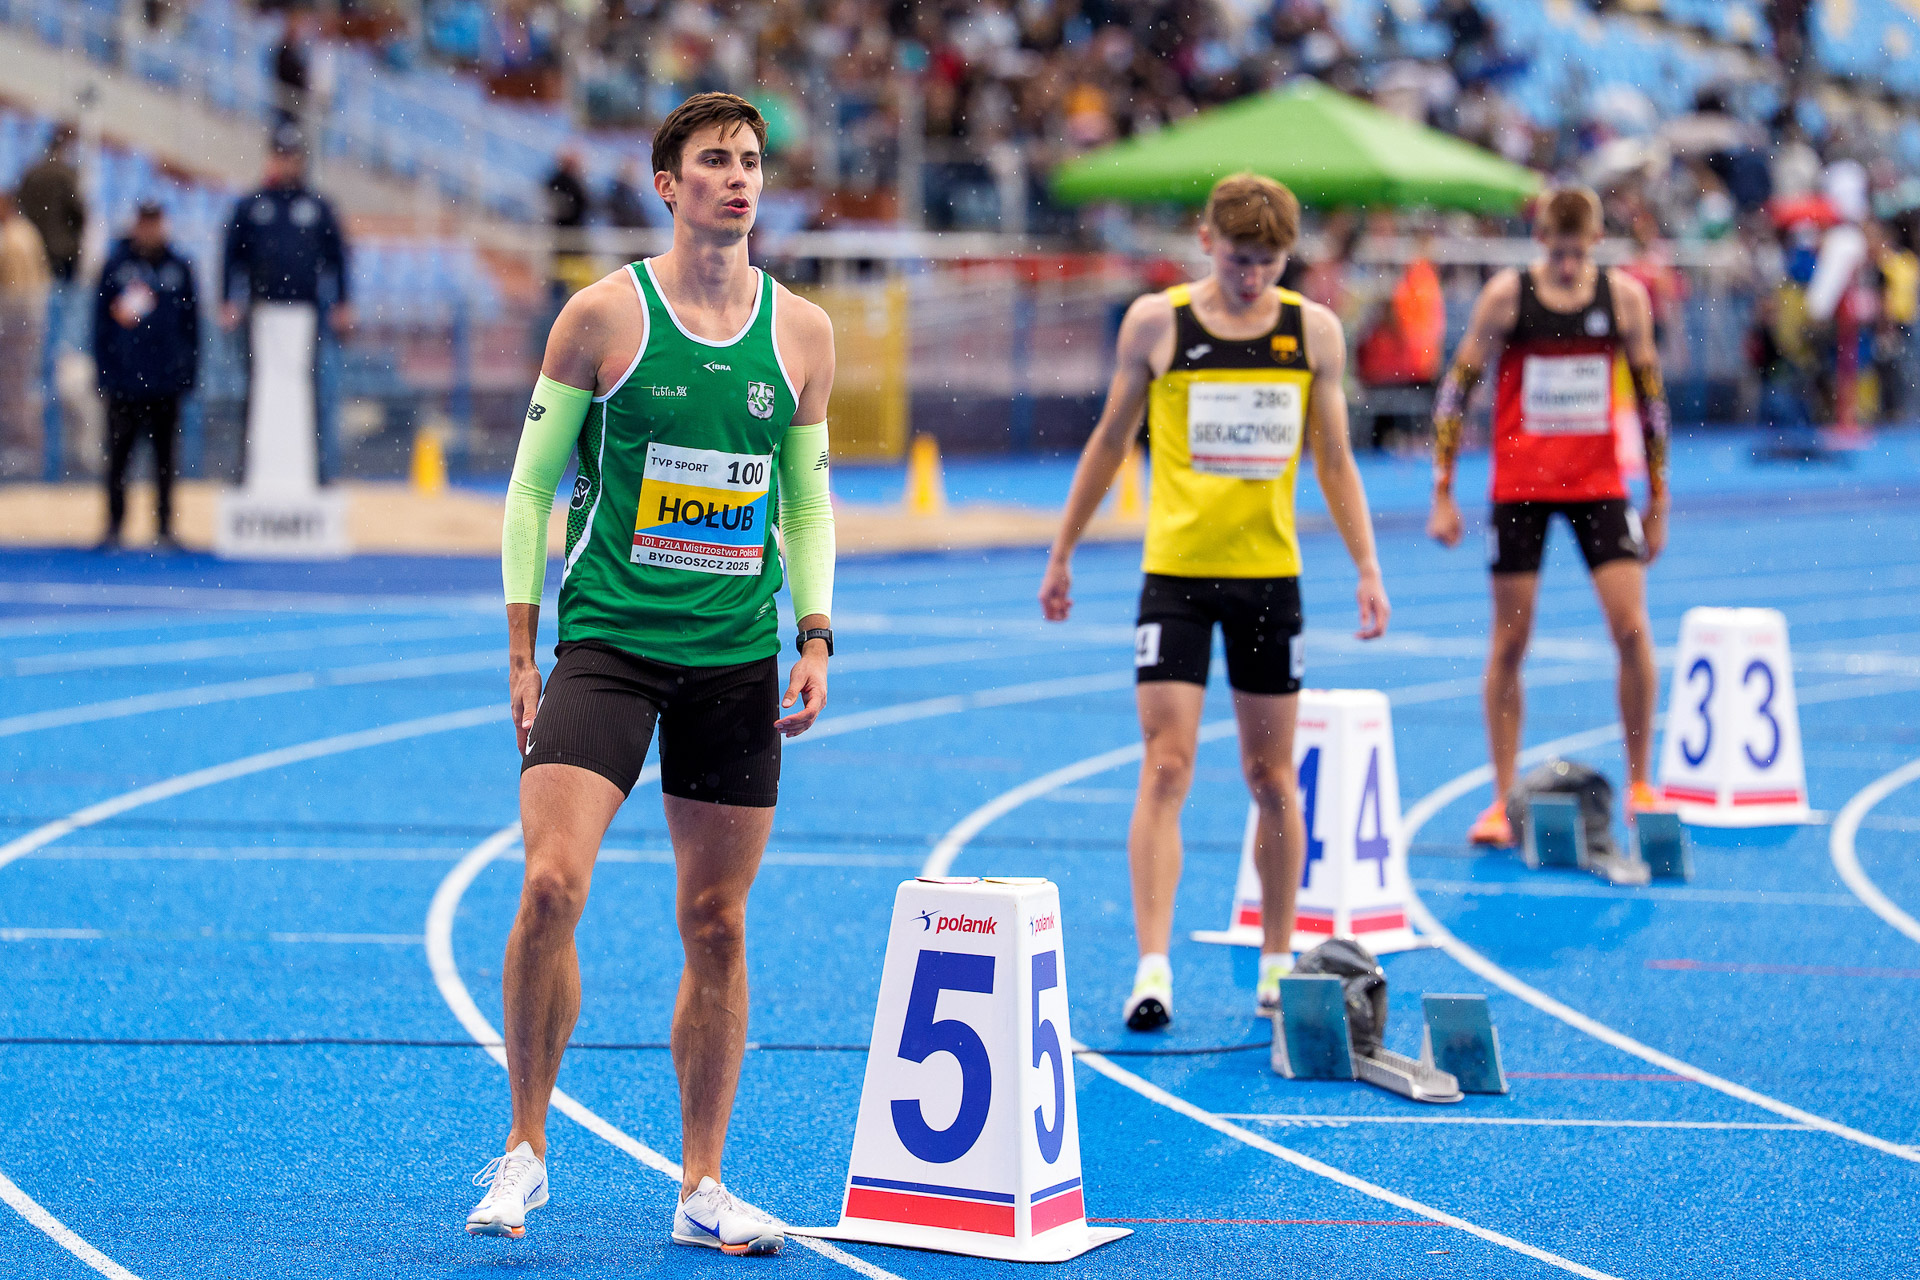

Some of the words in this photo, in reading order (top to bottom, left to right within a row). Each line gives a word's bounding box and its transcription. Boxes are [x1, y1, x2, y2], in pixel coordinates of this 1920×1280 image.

[711, 363, 732, 372] IBRA
[651, 457, 673, 467] TVP
[675, 461, 708, 472] SPORT
[727, 461, 764, 485] 100
[657, 496, 754, 531] HOŁUB
[641, 537, 657, 547] 101.
[658, 541, 681, 551] PZLA
[682, 543, 738, 557] Mistrzostwa
[739, 548, 759, 557] Polski
[649, 552, 723, 570] BYDGOSZCZ
[725, 561, 750, 571] 2025
[1681, 657, 1715, 766] 3
[1743, 660, 1780, 769] 3
[1355, 746, 1390, 888] 4
[936, 913, 998, 935] polanik
[1034, 911, 1055, 937] polanik
[890, 949, 996, 1164] 5
[1031, 949, 1065, 1165] 5
